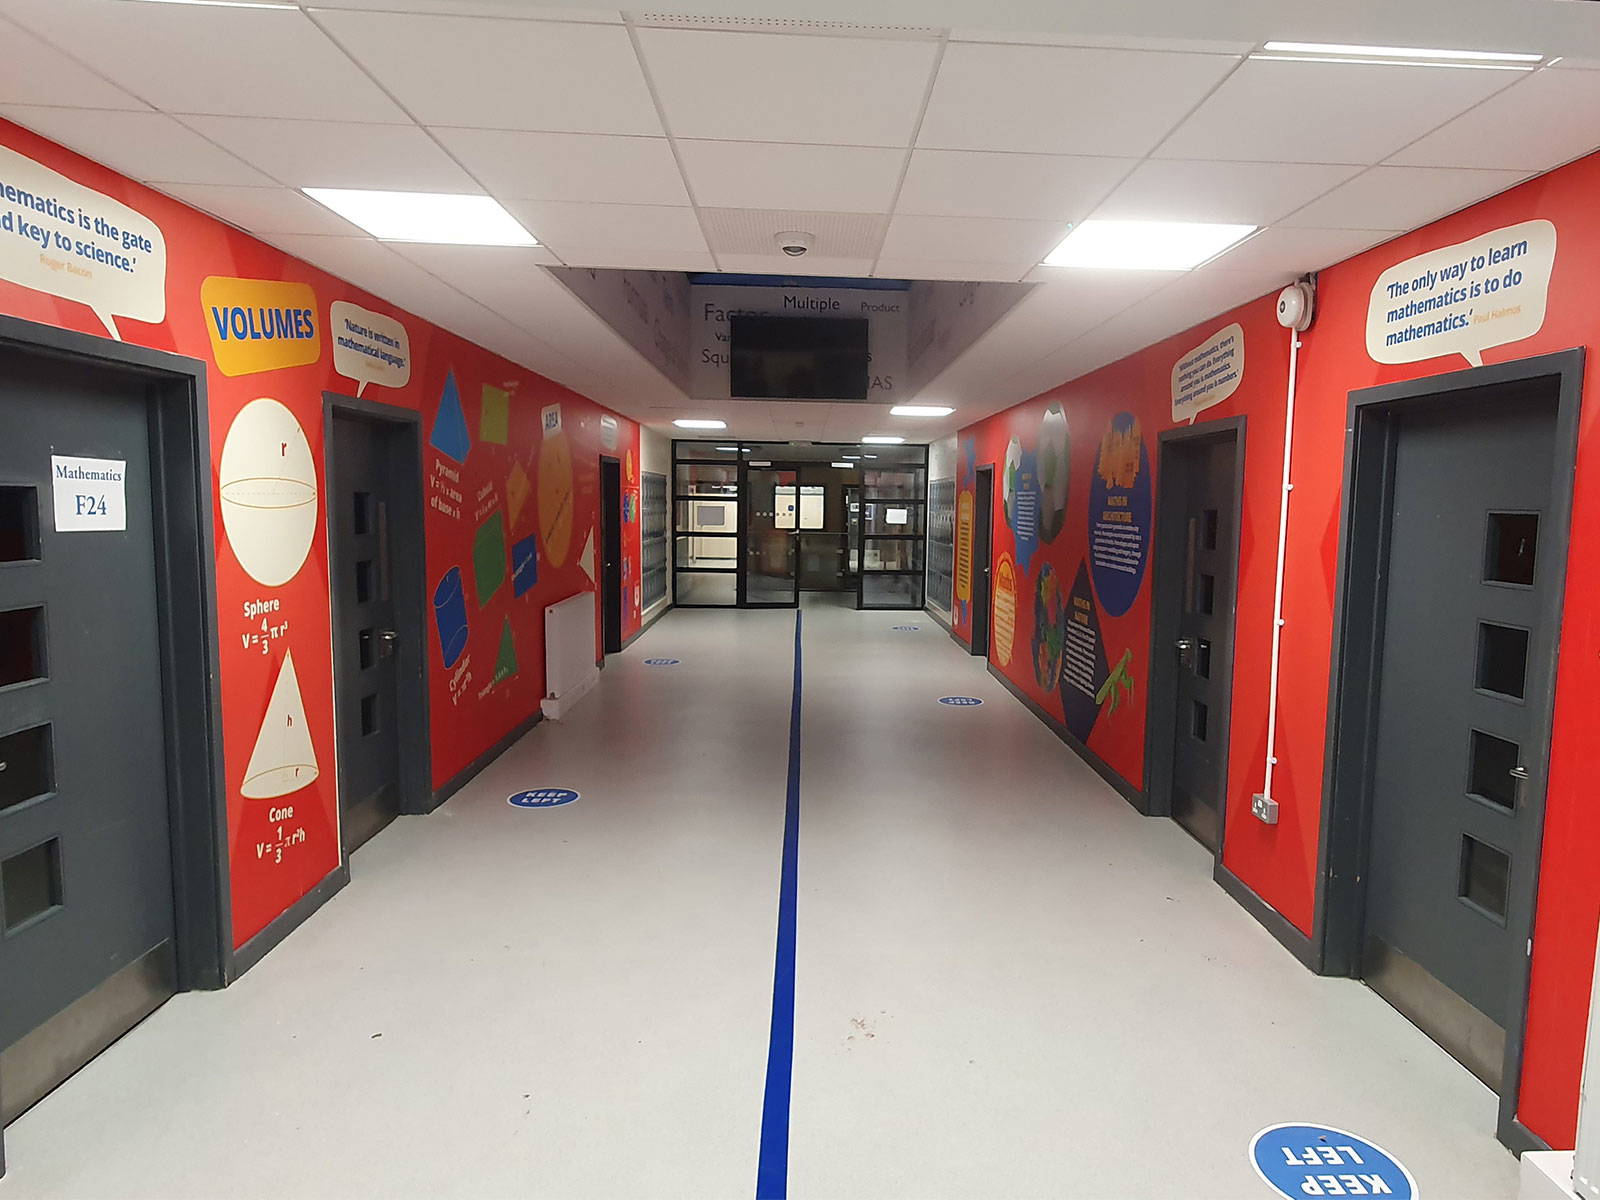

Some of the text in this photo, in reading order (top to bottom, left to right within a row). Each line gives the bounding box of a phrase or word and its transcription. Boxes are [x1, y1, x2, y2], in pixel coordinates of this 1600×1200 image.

[78, 208, 90, 230] is
[94, 218, 119, 240] the
[122, 231, 152, 254] gate
[0, 212, 136, 272] d key to science.'
[40, 253, 92, 279] Roger Bacon
[1387, 240, 1528, 299] 'The only way to learn
[784, 296, 840, 312] Multiple
[1387, 268, 1522, 323] mathematics is to do
[704, 304, 768, 322] Fac
[861, 302, 900, 314] Product
[212, 307, 314, 340] VOLUMES
[1386, 308, 1473, 346] mathematics.'
[338, 336, 379, 358] mathematical
[368, 327, 373, 339] is
[395, 338, 400, 349] in
[702, 349, 729, 367] Squ
[867, 376, 892, 395] AS
[281, 442, 286, 456] r
[56, 464, 122, 481] Mathematics
[75, 494, 107, 515] F24
[244, 599, 280, 620] Sphere
[287, 714, 292, 728] h
[295, 767, 299, 777] r
[269, 806, 293, 822] Cone
[1281, 1146, 1364, 1165] LEFT
[1301, 1174, 1393, 1195] KEEP
